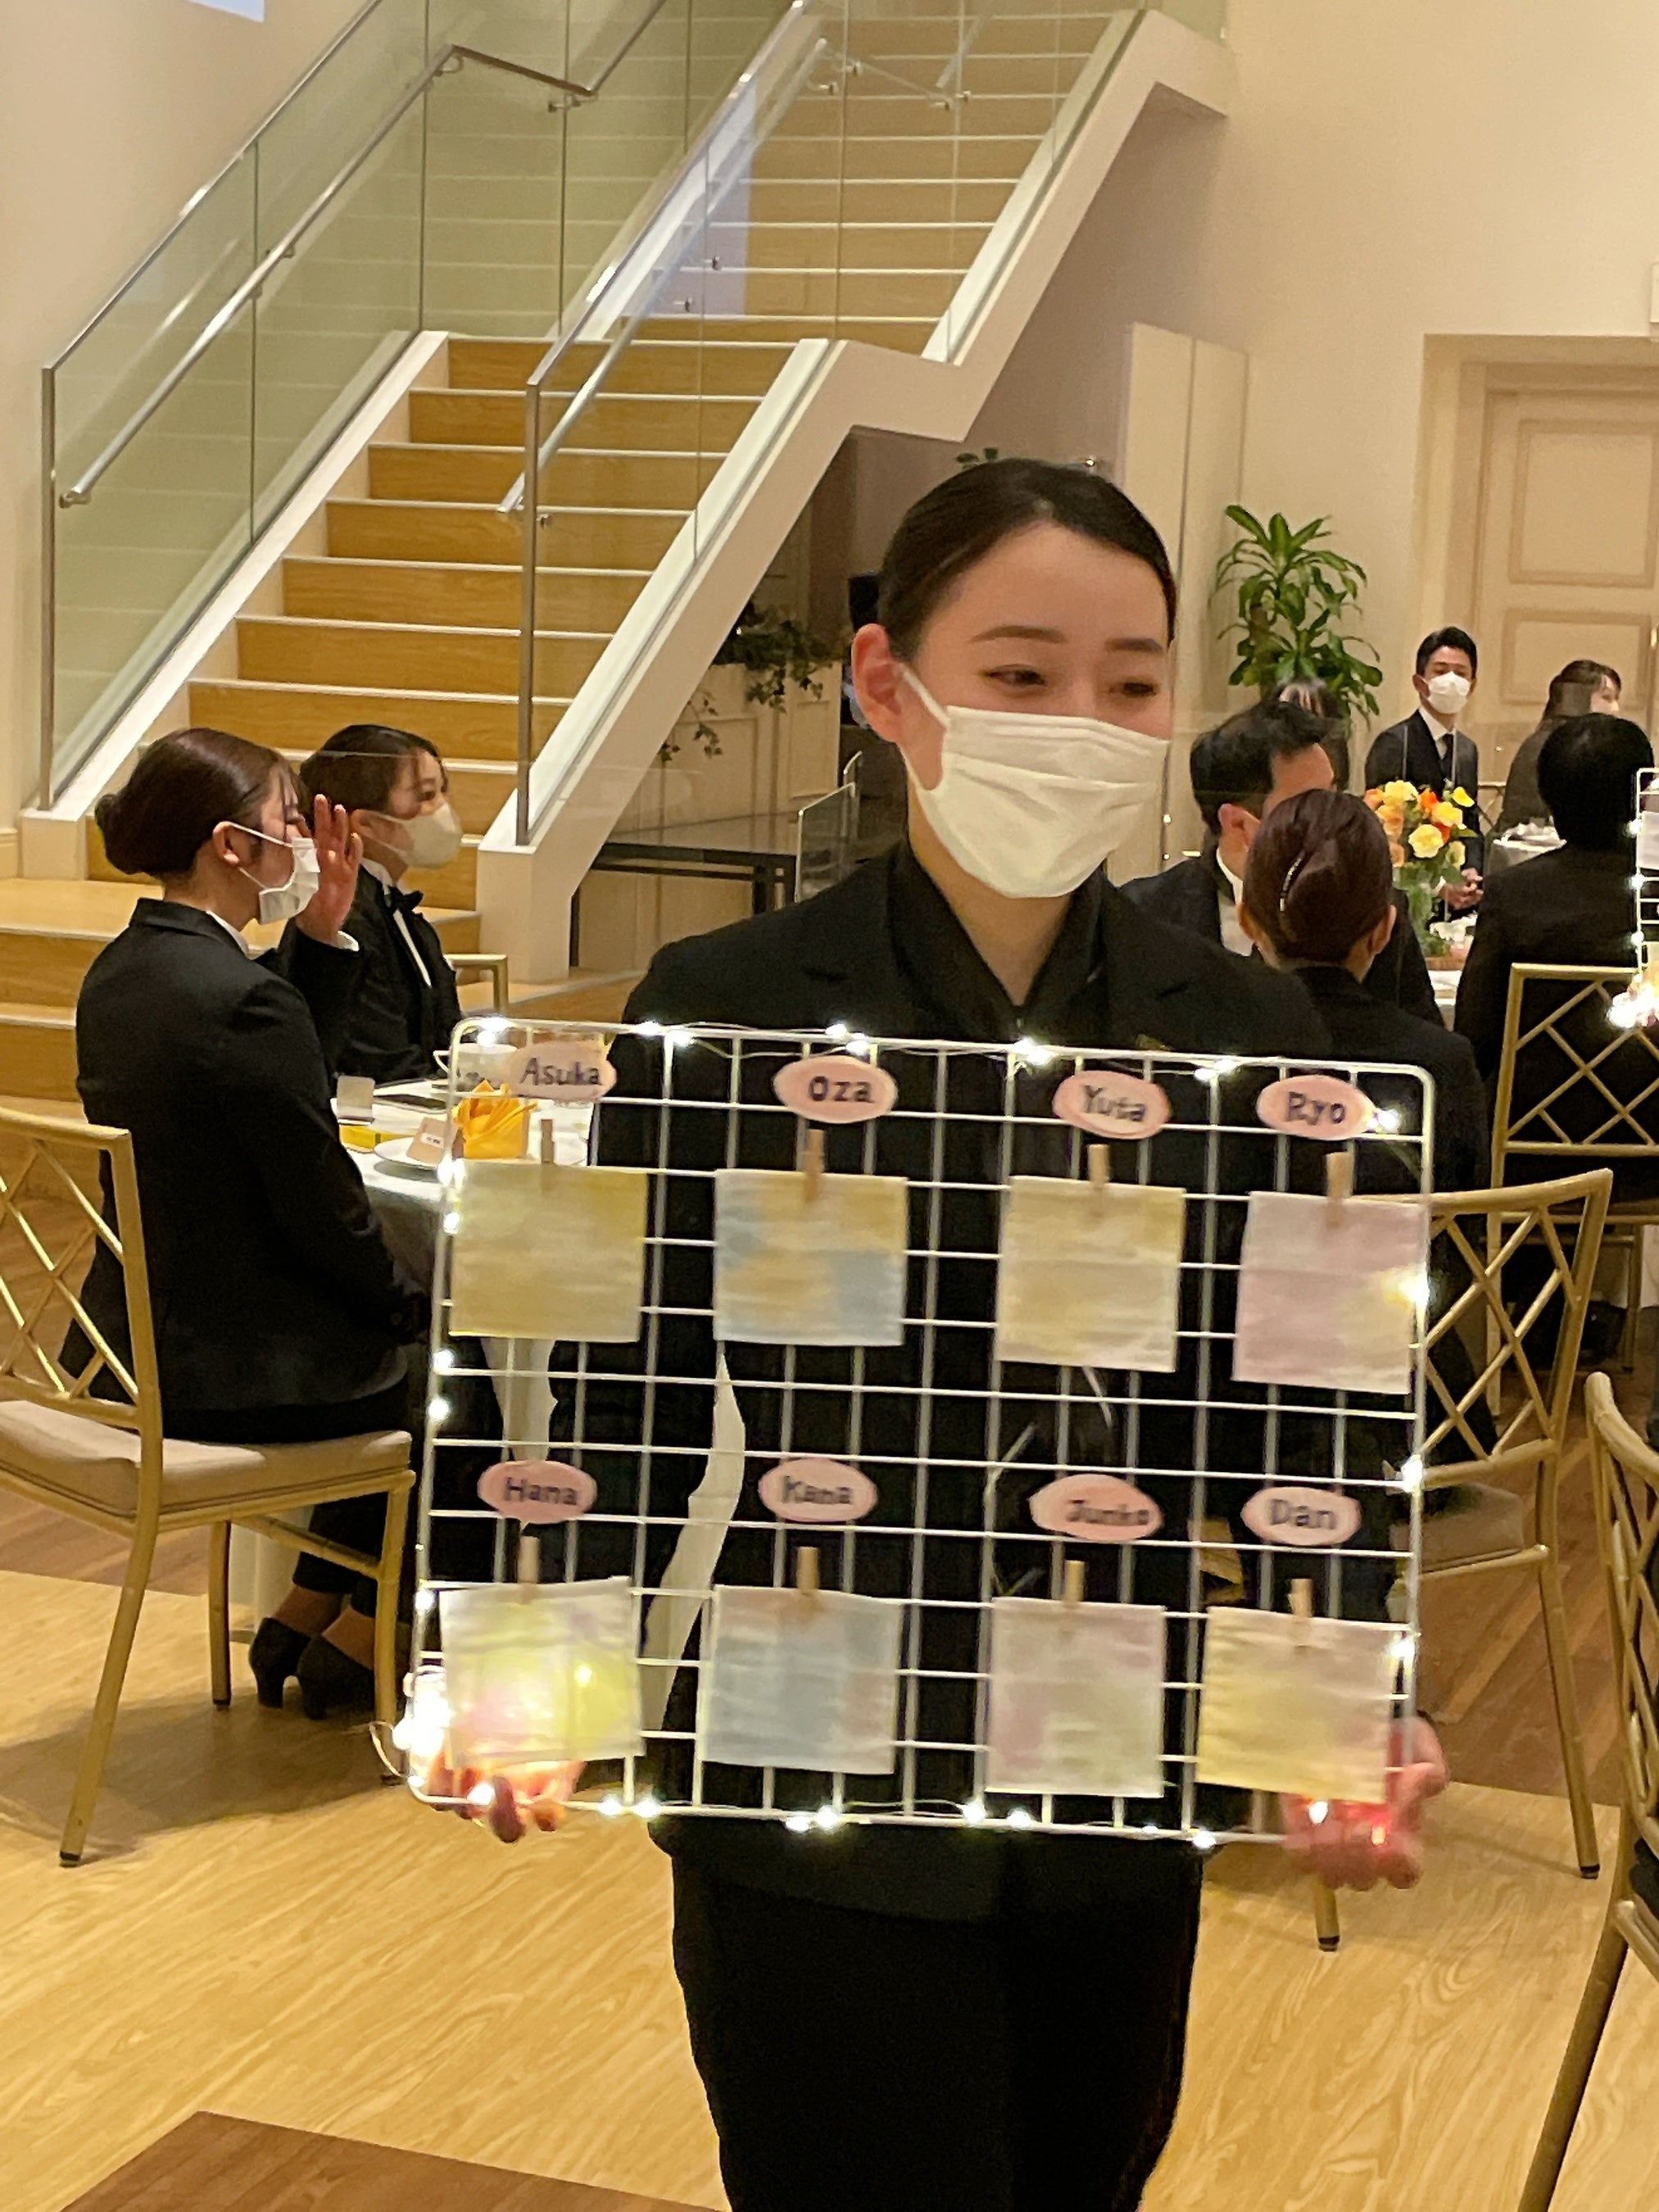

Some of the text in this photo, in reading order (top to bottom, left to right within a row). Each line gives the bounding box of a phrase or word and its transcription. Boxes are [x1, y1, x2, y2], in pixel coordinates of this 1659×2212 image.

[520, 1057, 601, 1086] Asuka
[809, 1077, 873, 1101] Oza
[1083, 1085, 1145, 1122] Yuta
[1286, 1090, 1345, 1126] Ryo
[504, 1477, 578, 1505] Hana
[782, 1475, 852, 1505] Kana
[1271, 1498, 1338, 1529] Dan
